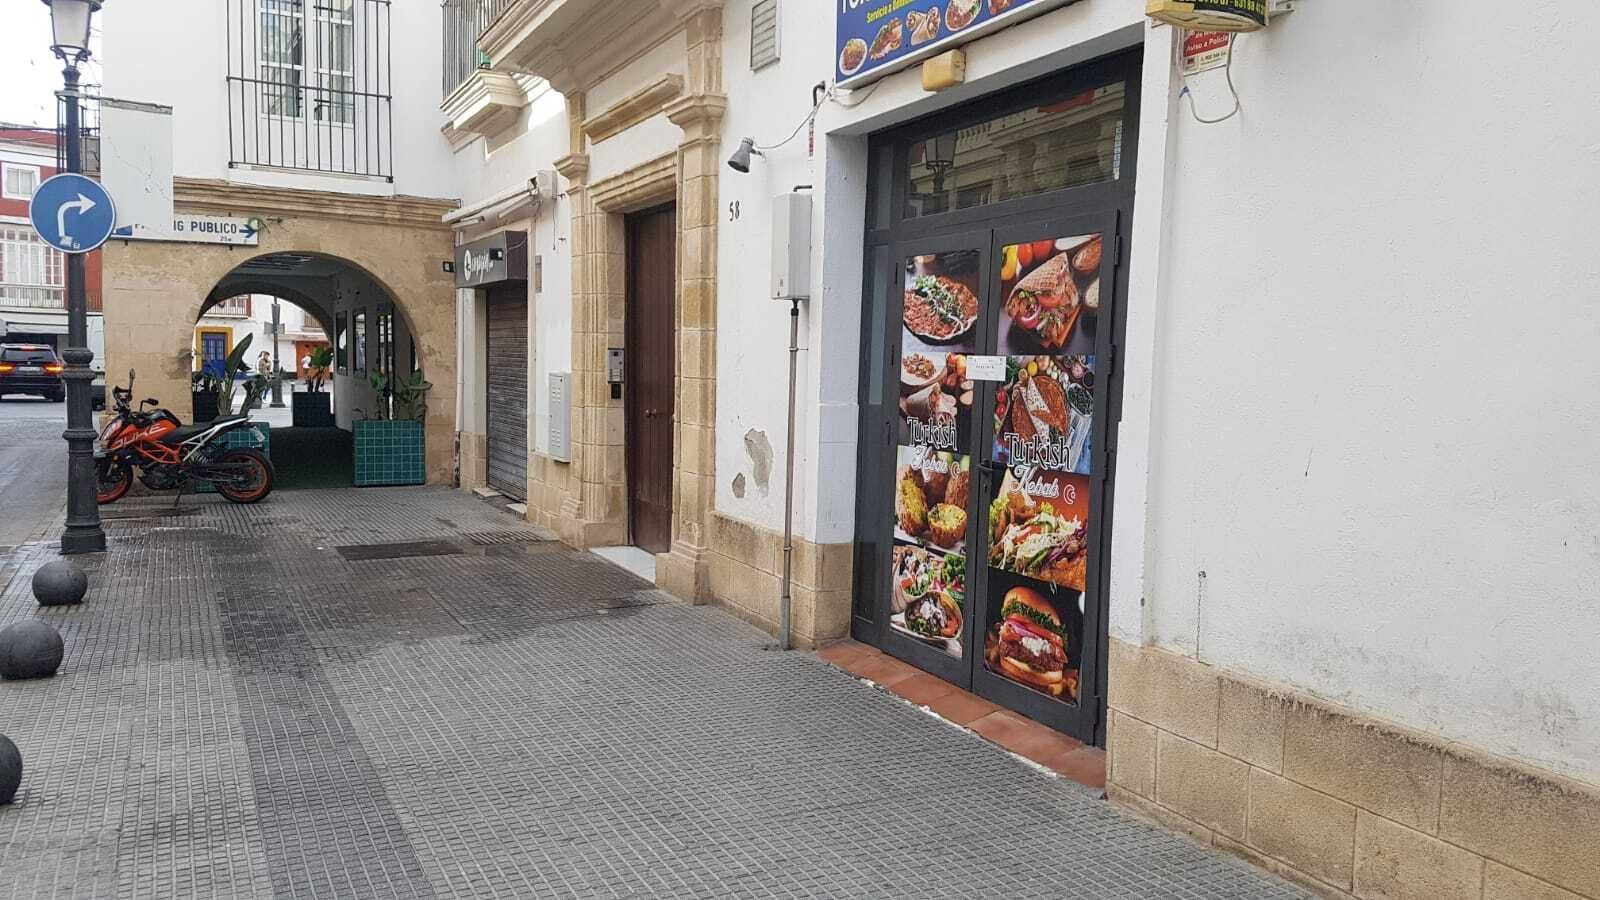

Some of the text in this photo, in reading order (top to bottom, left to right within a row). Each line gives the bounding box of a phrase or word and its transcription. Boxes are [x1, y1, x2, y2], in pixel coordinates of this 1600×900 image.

[190, 220, 237, 234] PUBLICO
[729, 199, 740, 222] 58
[907, 416, 959, 451] Turkish
[1003, 431, 1072, 472] Turkish
[911, 444, 949, 483] Kebab
[1009, 464, 1060, 509] Kebab
